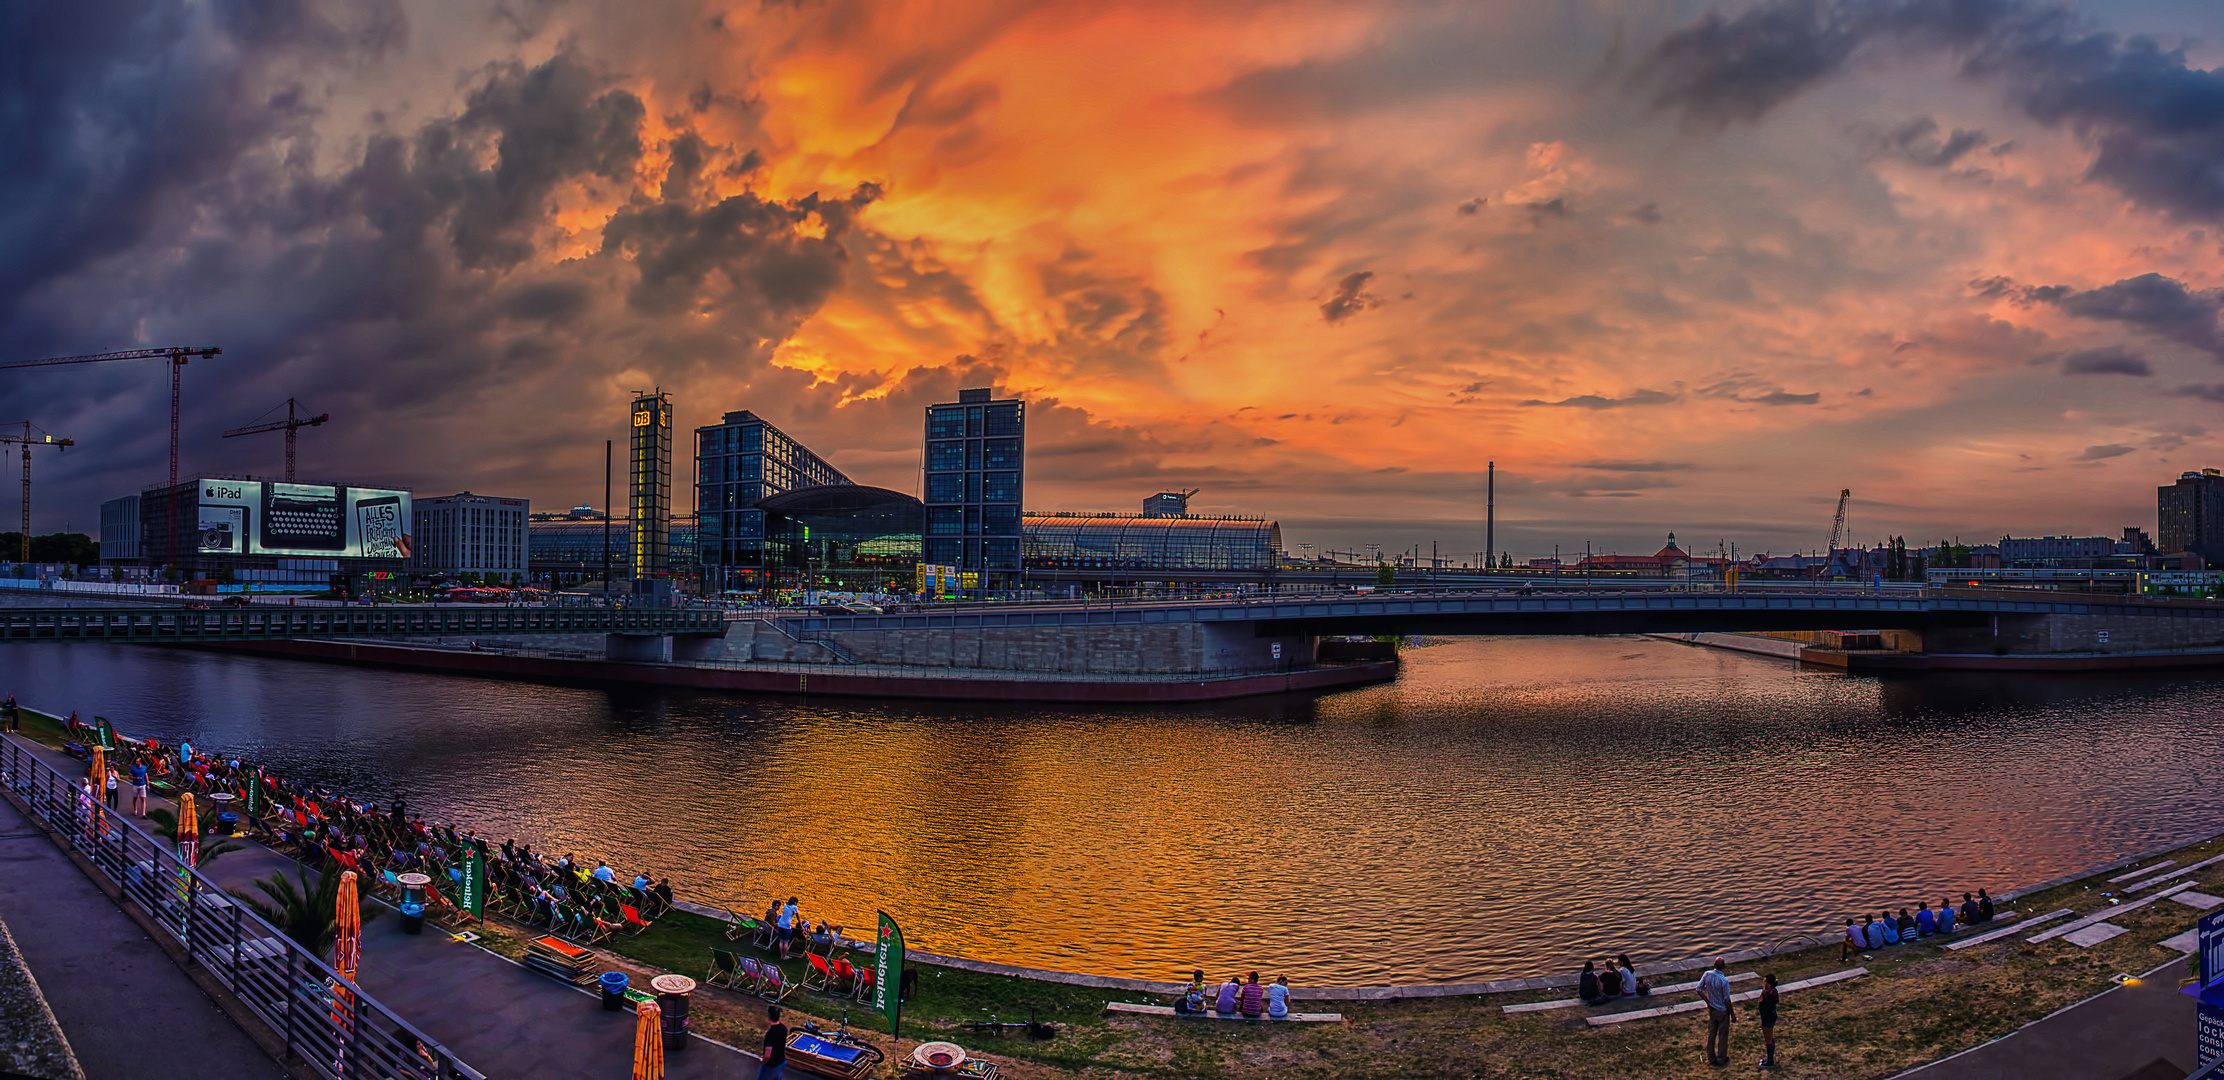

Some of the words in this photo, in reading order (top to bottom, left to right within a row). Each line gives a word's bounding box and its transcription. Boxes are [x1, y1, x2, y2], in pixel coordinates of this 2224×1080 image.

[636, 412, 648, 424] DB
[217, 487, 241, 499] iPad
[366, 506, 394, 524] ALLES
[372, 519, 386, 529] IST
[369, 571, 395, 580] PIZZA
